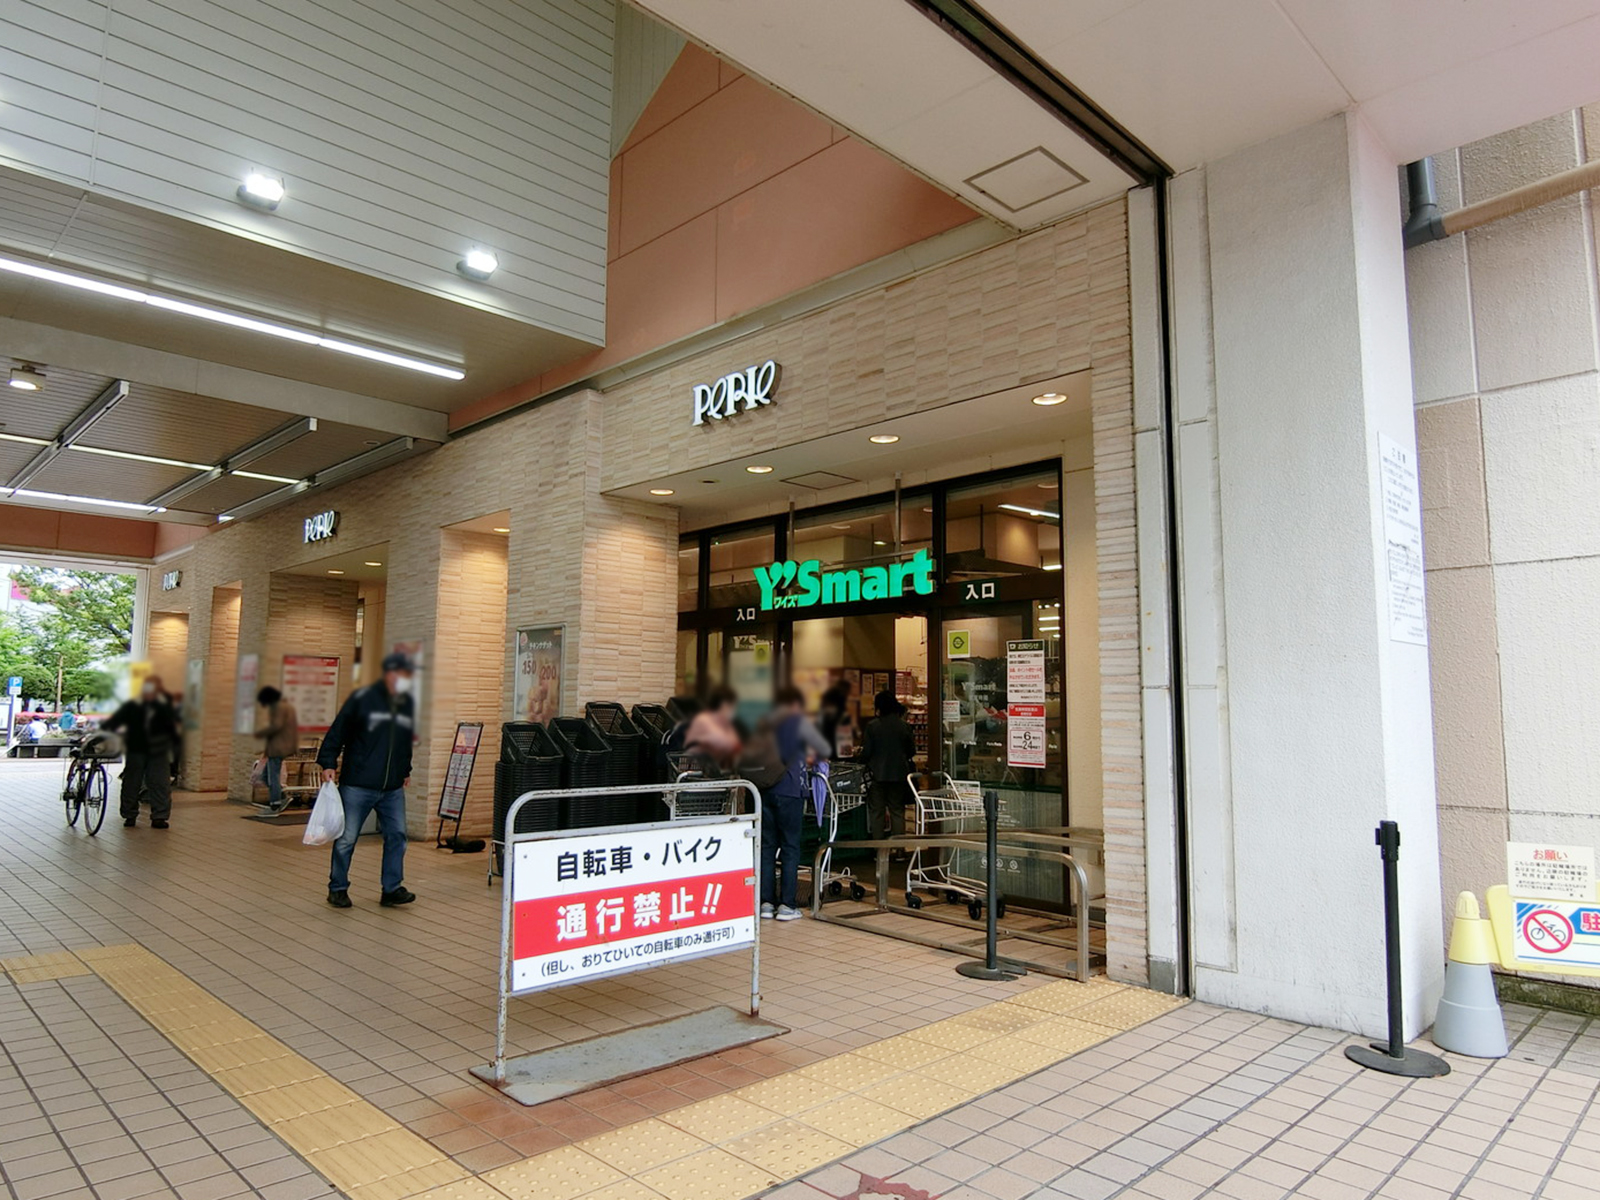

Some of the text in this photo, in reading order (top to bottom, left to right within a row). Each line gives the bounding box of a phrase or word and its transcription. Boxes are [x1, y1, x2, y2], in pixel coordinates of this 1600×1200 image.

[965, 582, 996, 600] 入口
[774, 594, 798, 609] ワイズ
[736, 607, 756, 621] 入口
[1023, 731, 1031, 741] 6
[1022, 740, 1033, 750] 24
[556, 836, 722, 882] 自転車・バイク
[1533, 849, 1568, 861] お願い
[556, 883, 722, 941] 通行禁止!!
[1582, 912, 1600, 931] 駐
